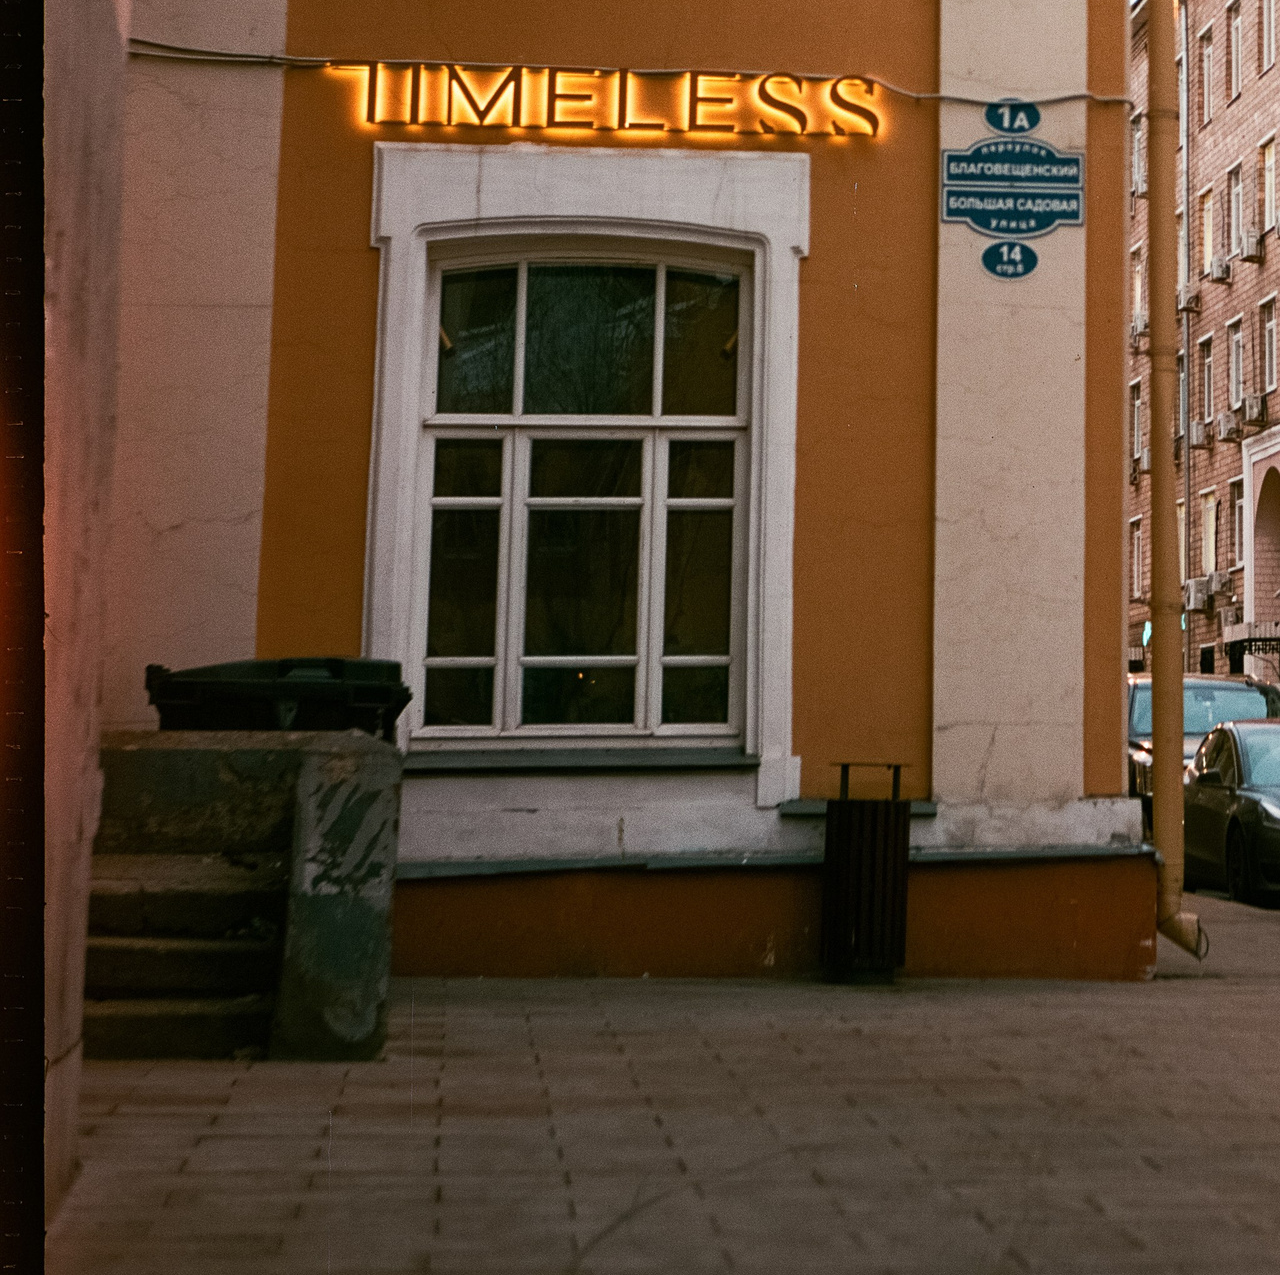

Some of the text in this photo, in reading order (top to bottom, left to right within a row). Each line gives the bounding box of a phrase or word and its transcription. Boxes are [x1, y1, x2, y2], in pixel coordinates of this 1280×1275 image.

[326, 61, 881, 137] TIMELESS
[997, 105, 1030, 129] 1А
[980, 142, 1047, 158] переулок
[949, 162, 1079, 178] БЛАГОВЕЩЕНСКИЙ
[949, 196, 1078, 213] БОЛЬШАЯ САДОВАЯ
[990, 218, 1037, 230] улица
[999, 244, 1022, 262] 14
